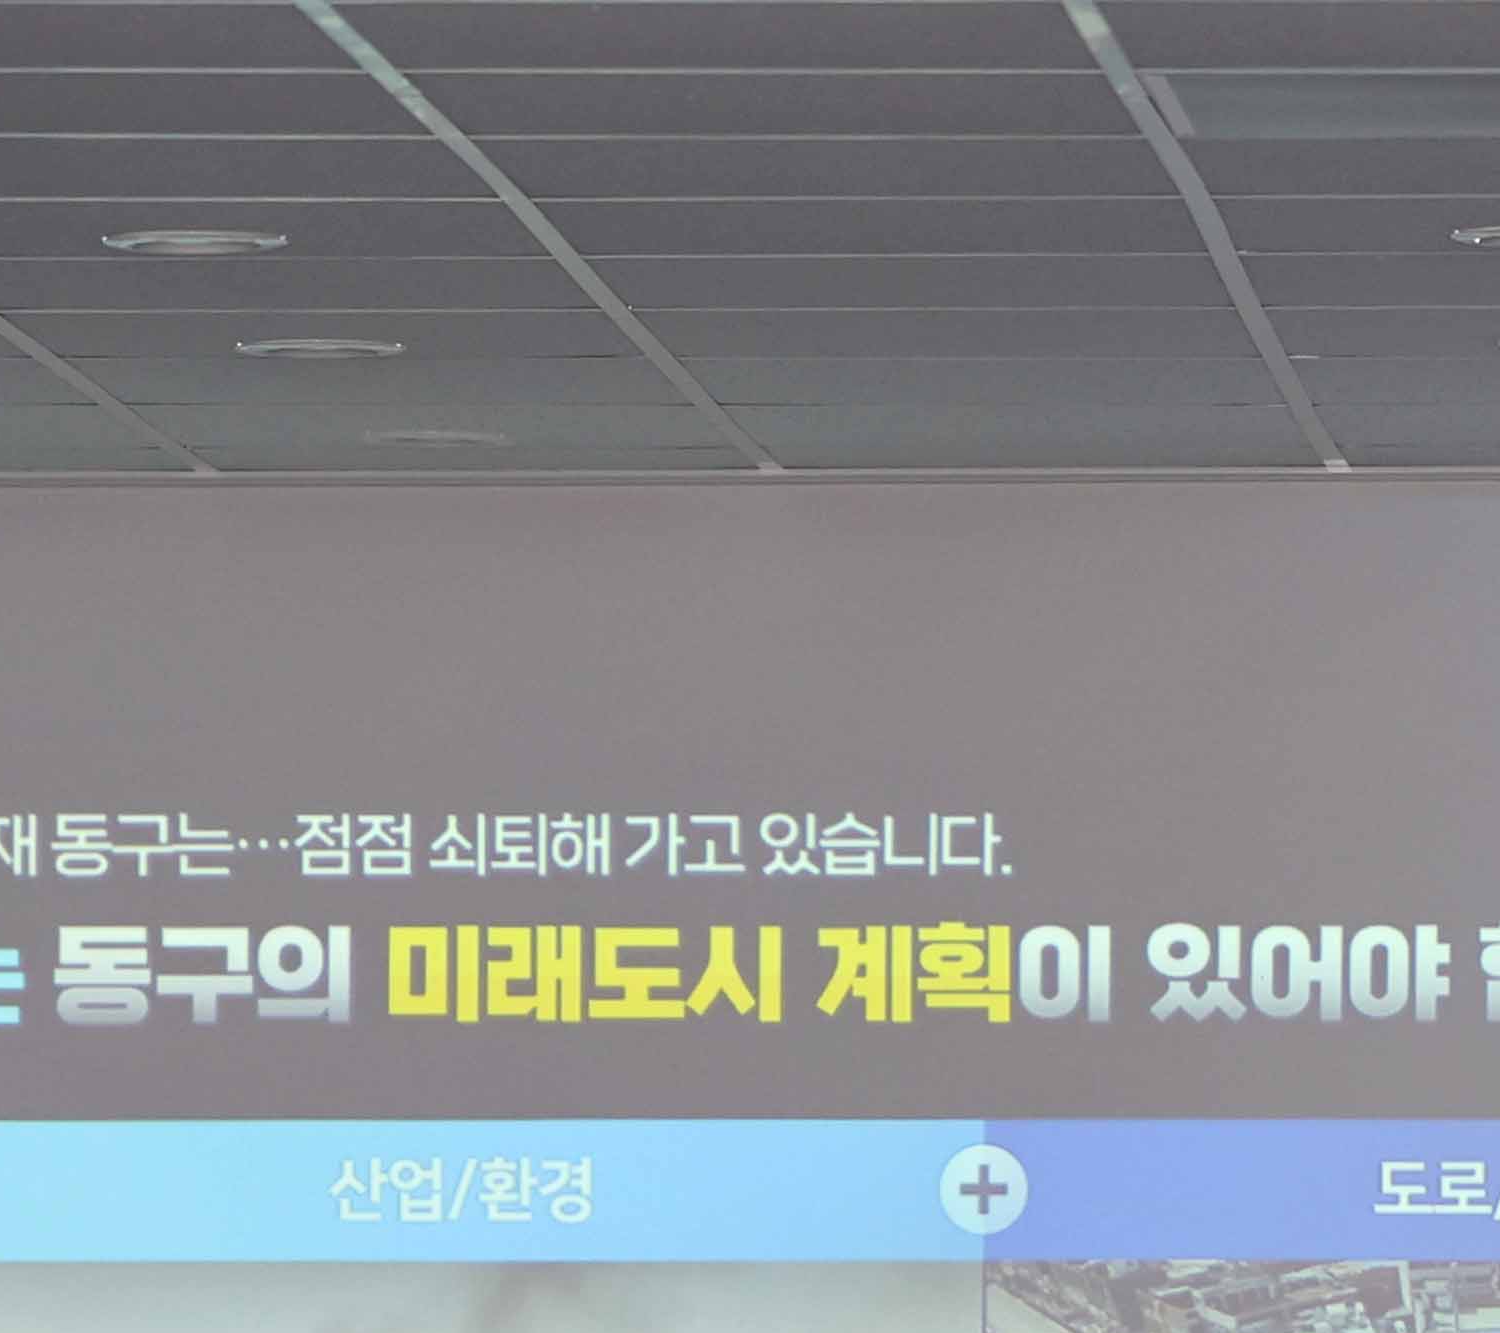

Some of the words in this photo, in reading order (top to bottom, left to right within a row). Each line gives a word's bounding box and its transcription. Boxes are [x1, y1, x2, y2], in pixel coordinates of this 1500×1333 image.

[429, 812, 611, 877] 쇠퇴해
[624, 812, 746, 876] 가고
[759, 812, 1013, 877] 있습니다.
[53, 922, 352, 1026] 동구의
[387, 922, 784, 1025] 미래도시
[816, 921, 1113, 1024] 계획이
[1146, 921, 1451, 1023] 있어야
[326, 1156, 593, 1224] 산업/환경
